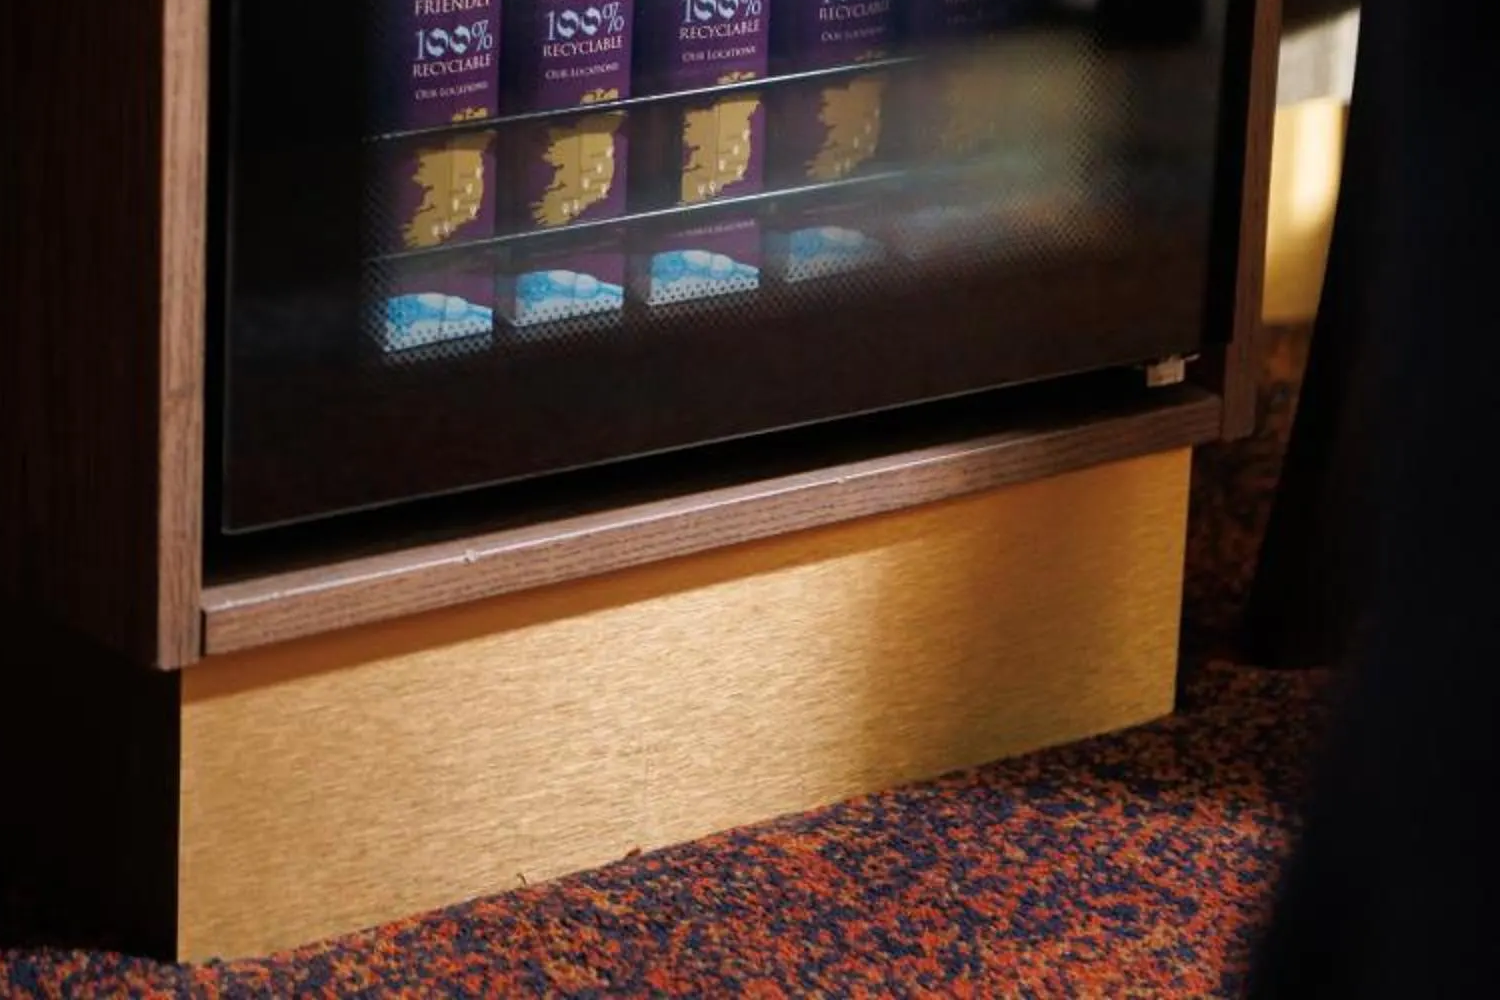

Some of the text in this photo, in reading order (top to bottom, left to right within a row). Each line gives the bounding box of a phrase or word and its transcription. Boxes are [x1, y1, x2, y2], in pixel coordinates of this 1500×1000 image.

[545, 1, 625, 41] 100%
[679, 18, 761, 41] RECYCLABLE
[415, 19, 493, 60] 100%
[543, 35, 623, 58] RECYCLABLE
[413, 54, 491, 77] RECYCLABLE
